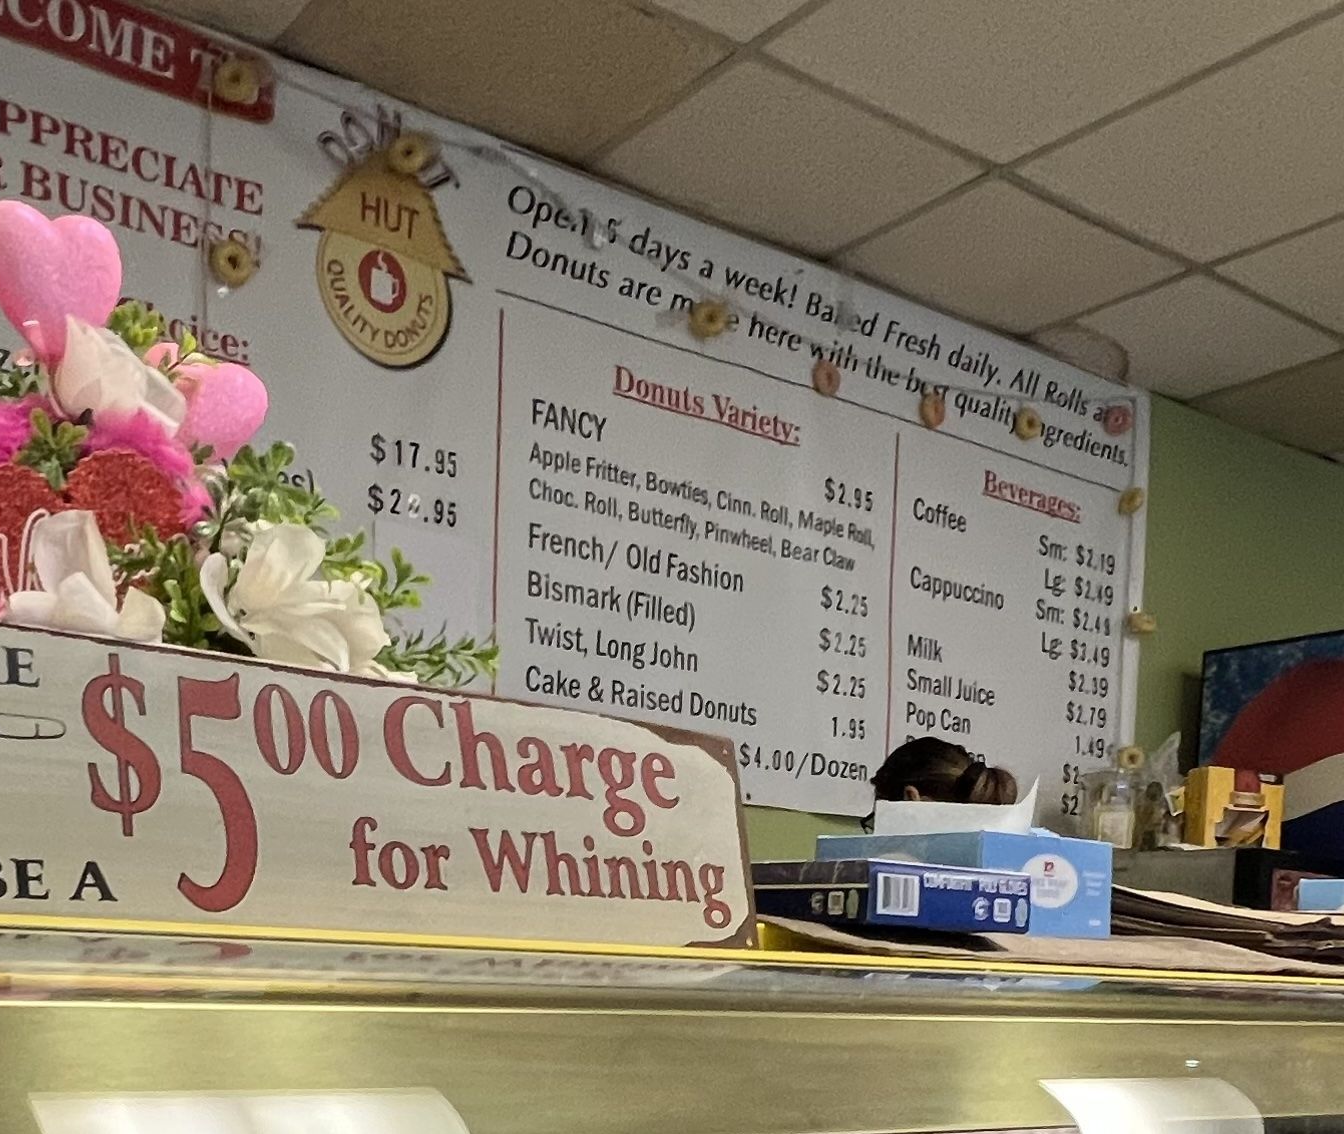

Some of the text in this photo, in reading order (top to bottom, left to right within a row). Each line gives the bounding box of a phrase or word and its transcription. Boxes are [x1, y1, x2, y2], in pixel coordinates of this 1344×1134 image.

[361, 192, 419, 238] HUT
[327, 259, 433, 348] QUALITY DONUTS
[506, 231, 610, 288] Donuts
[618, 277, 662, 306] are
[669, 292, 739, 333] me
[747, 312, 802, 351] here
[865, 355, 900, 385] the
[629, 227, 691, 273] days
[699, 258, 714, 278] a
[725, 265, 797, 308] week!
[882, 320, 940, 360] Fresh
[948, 345, 1001, 387] daily.
[1010, 369, 1039, 398] All
[1045, 380, 1087, 416] Rolls
[531, 398, 607, 442] FANCY
[614, 365, 801, 443] Donuts Variety:
[370, 433, 456, 477] $17.95
[529, 442, 876, 550] Apple Fritter, Bowties, Cinn. Roll, Maple Roll,
[913, 497, 967, 532] Coffee
[984, 469, 1082, 521] Beverages:
[528, 478, 855, 572] Choc. Roll, Butterfly, Pinwheel, Bear Claw
[626, 543, 661, 575] Old
[667, 553, 744, 592] Fashion
[1039, 534, 1068, 562] Sm:
[527, 570, 697, 633] Bismark (Filled)
[820, 584, 868, 618] $2.25
[910, 566, 1005, 610] Cappuccino
[1036, 599, 1064, 625] Sm:
[525, 618, 698, 673] Twist, Long John
[819, 627, 867, 658] $2.25
[907, 634, 943, 663] Milk
[525, 665, 758, 727] Cake & Raised Donuts
[816, 669, 866, 699] $2.25
[906, 668, 952, 698] Small
[955, 678, 996, 706] Juice
[831, 716, 866, 740] 1.95
[906, 701, 936, 732] Pop
[941, 709, 971, 734] Can
[384, 695, 680, 838] Charge
[739, 742, 868, 782] $4.00/Dozen
[69, 860, 117, 903] A
[350, 816, 731, 930] for Whining
